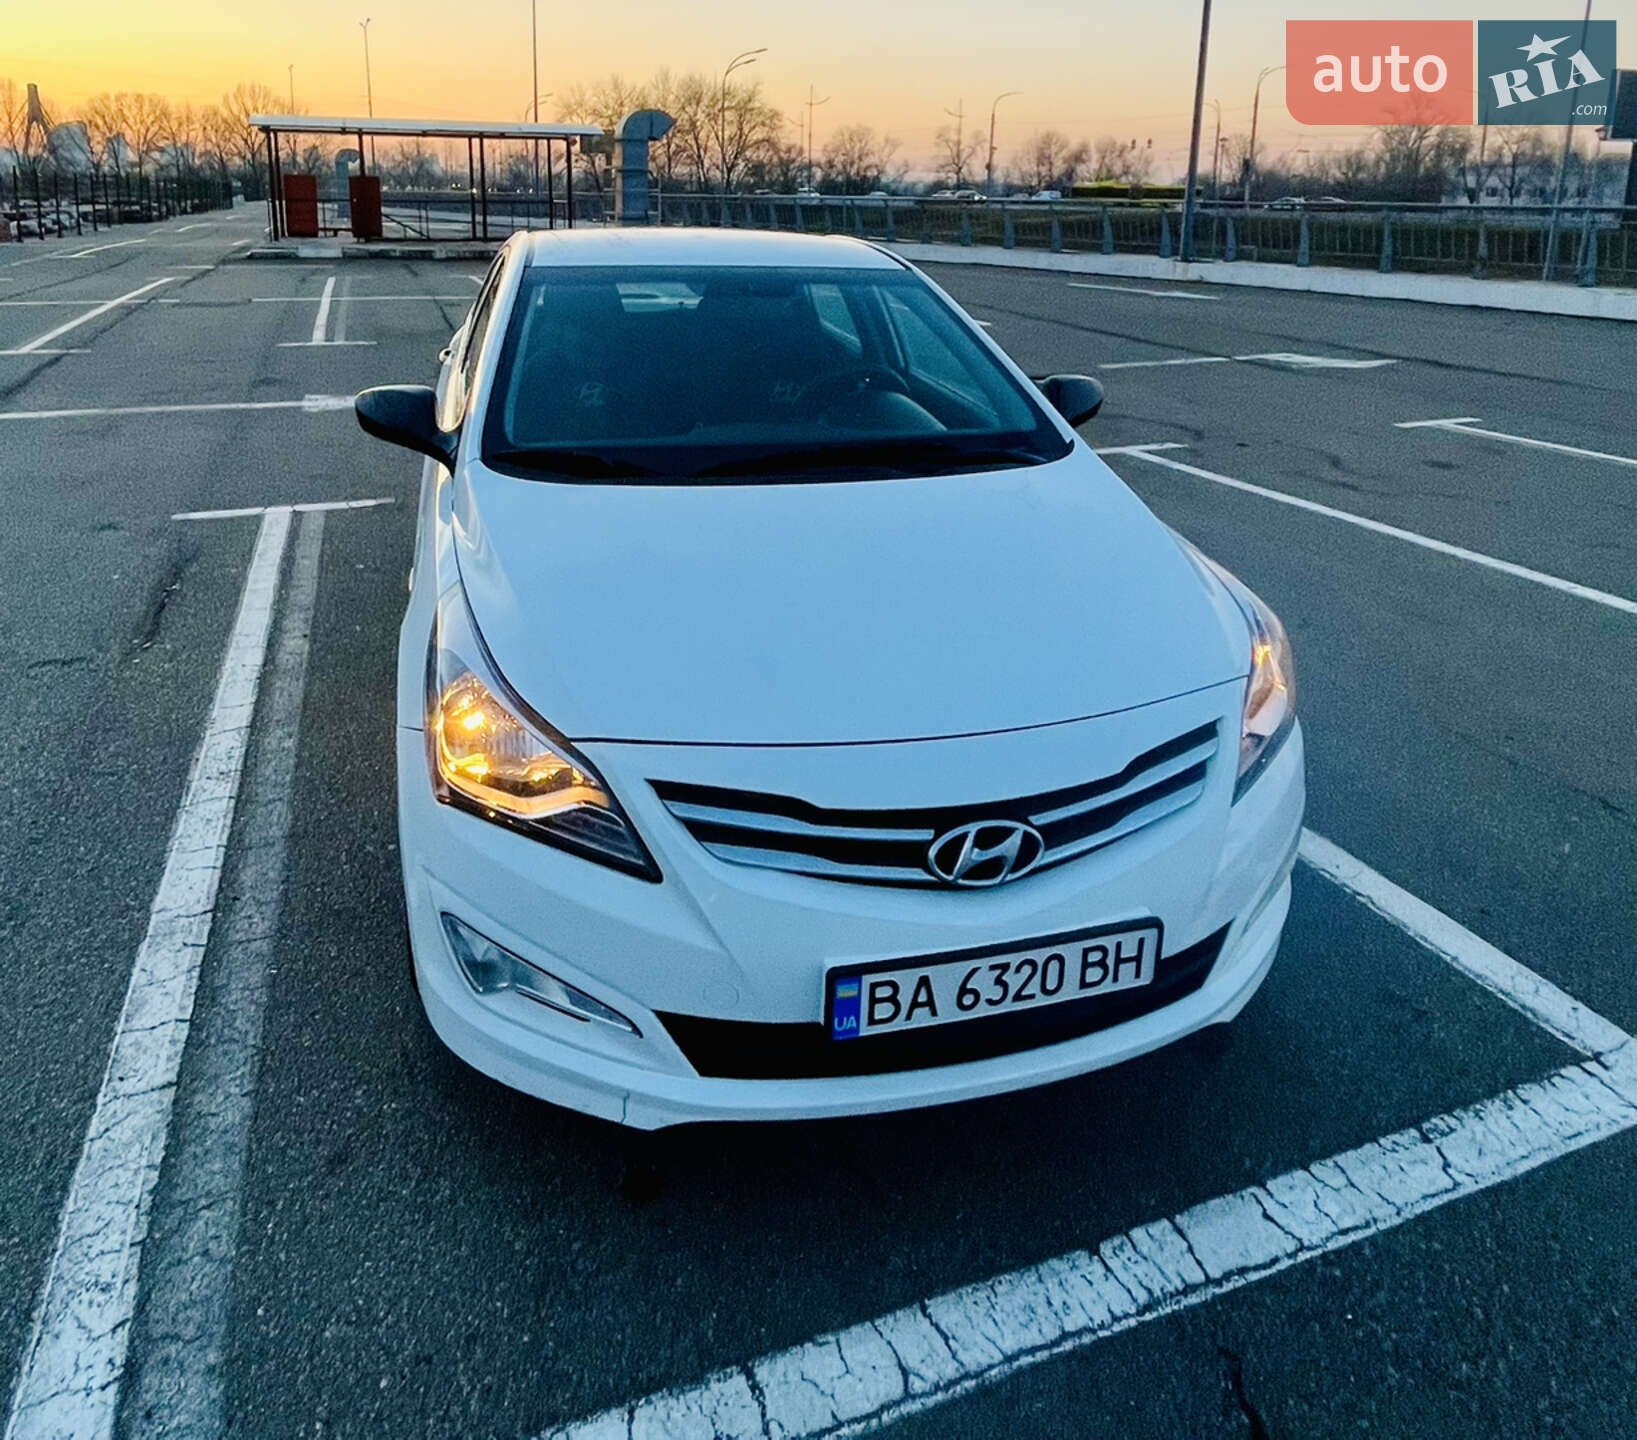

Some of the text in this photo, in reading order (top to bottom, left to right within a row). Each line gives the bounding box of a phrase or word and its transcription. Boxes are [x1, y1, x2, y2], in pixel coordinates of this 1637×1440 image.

[867, 936, 1146, 1027] BA 6320 BH
[833, 1015, 858, 1032] UA
